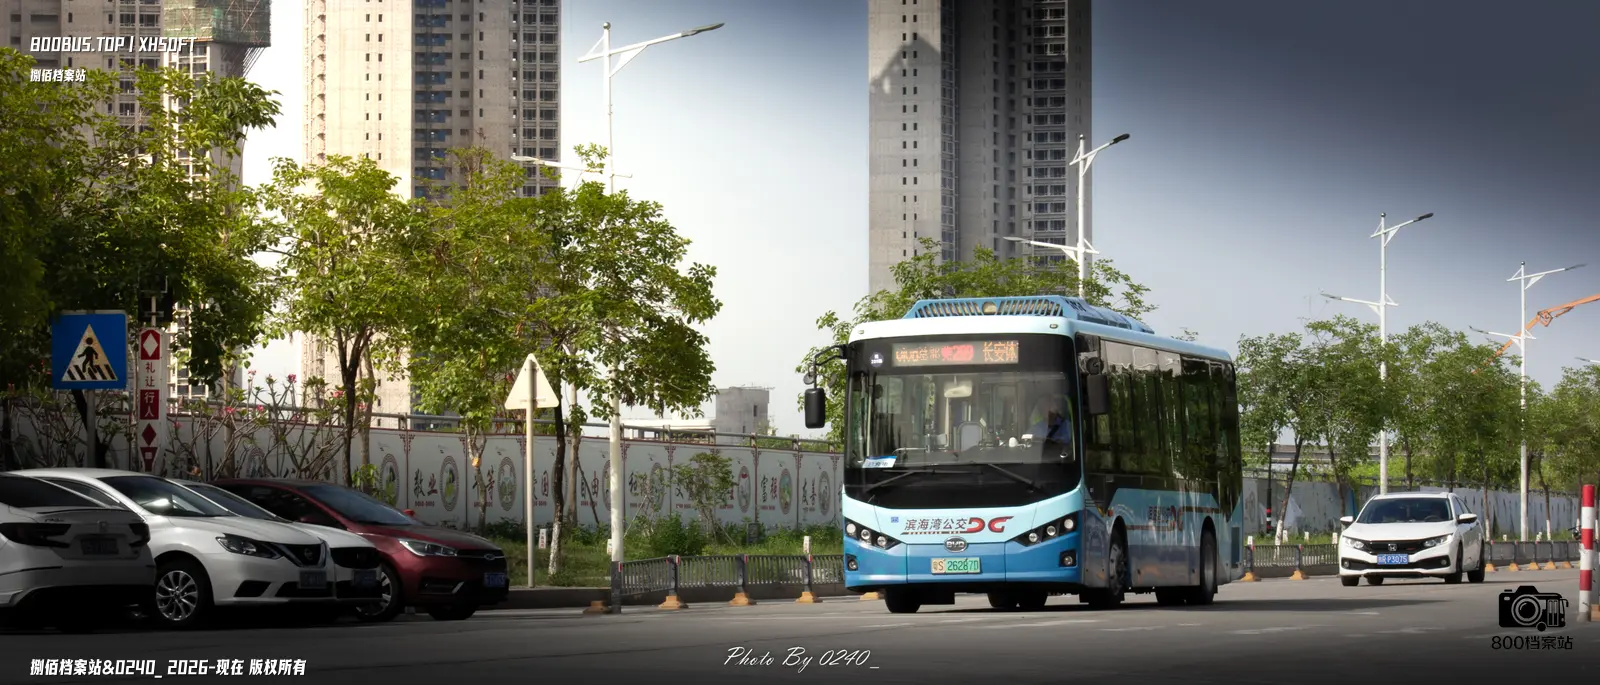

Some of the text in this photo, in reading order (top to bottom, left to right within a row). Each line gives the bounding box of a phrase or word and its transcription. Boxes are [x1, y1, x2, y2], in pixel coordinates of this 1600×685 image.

[144, 361, 156, 418] 礼让行人
[904, 518, 967, 531] 滨海湾公交
[946, 540, 965, 548] BYD
